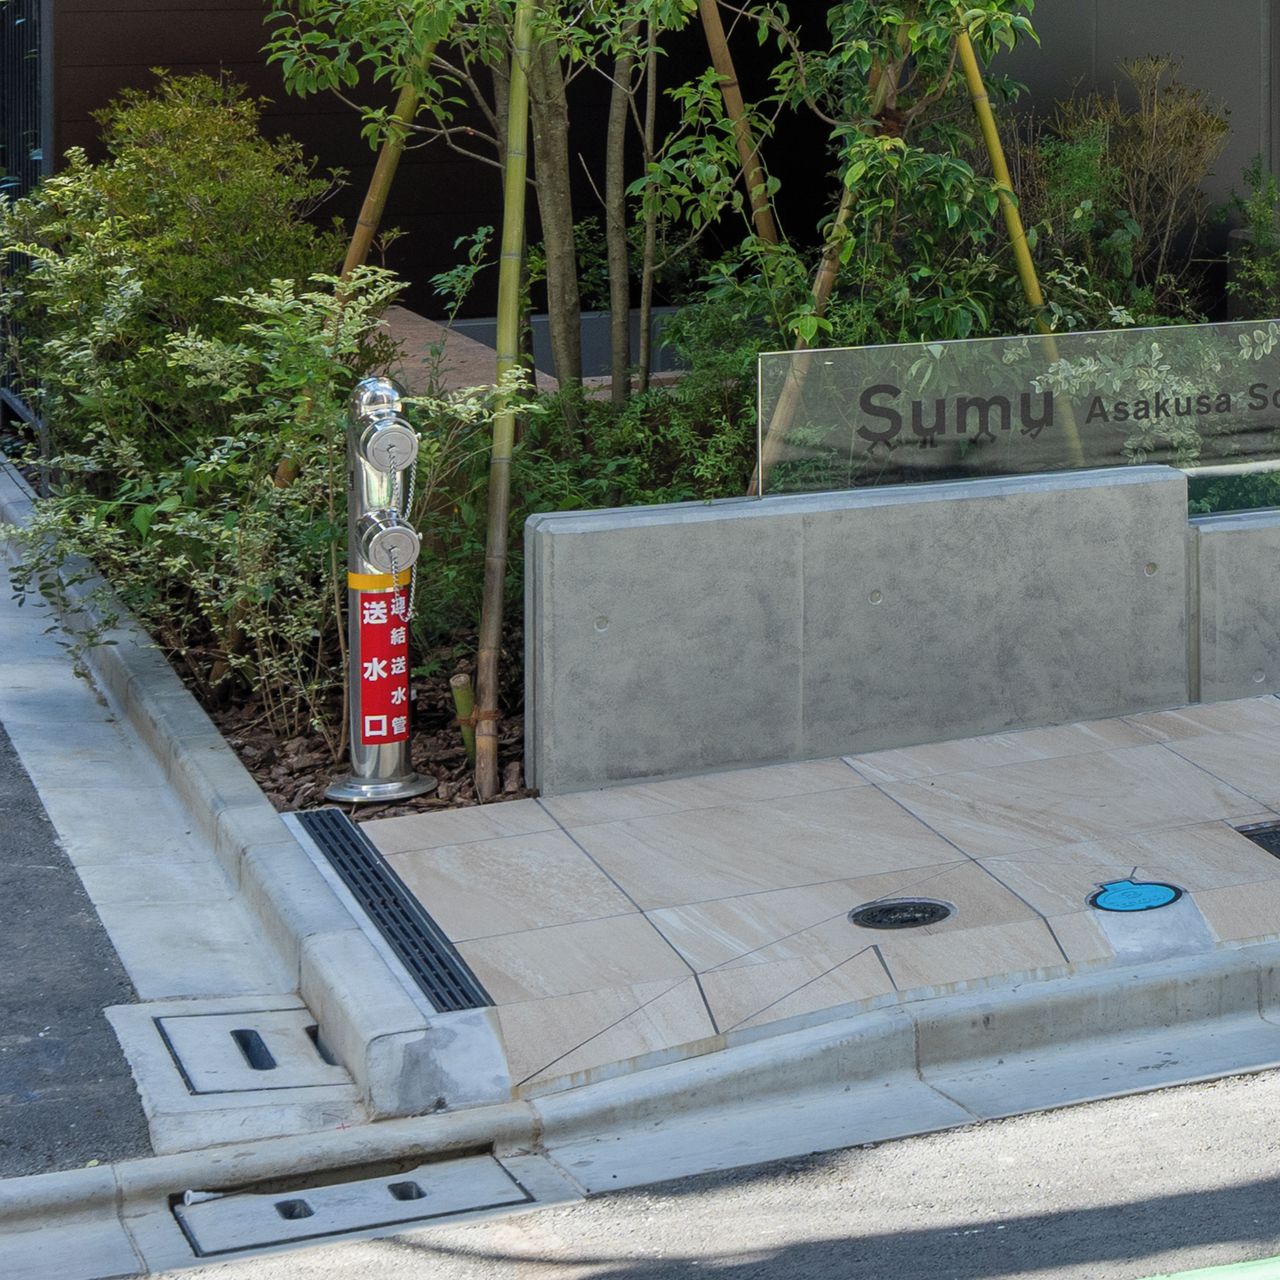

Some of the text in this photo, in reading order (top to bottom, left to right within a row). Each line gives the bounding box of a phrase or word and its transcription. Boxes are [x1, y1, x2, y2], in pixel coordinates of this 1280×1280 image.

[856, 383, 1053, 455] Sumu
[1085, 391, 1232, 425] Asakusa
[363, 600, 388, 738] 送水口
